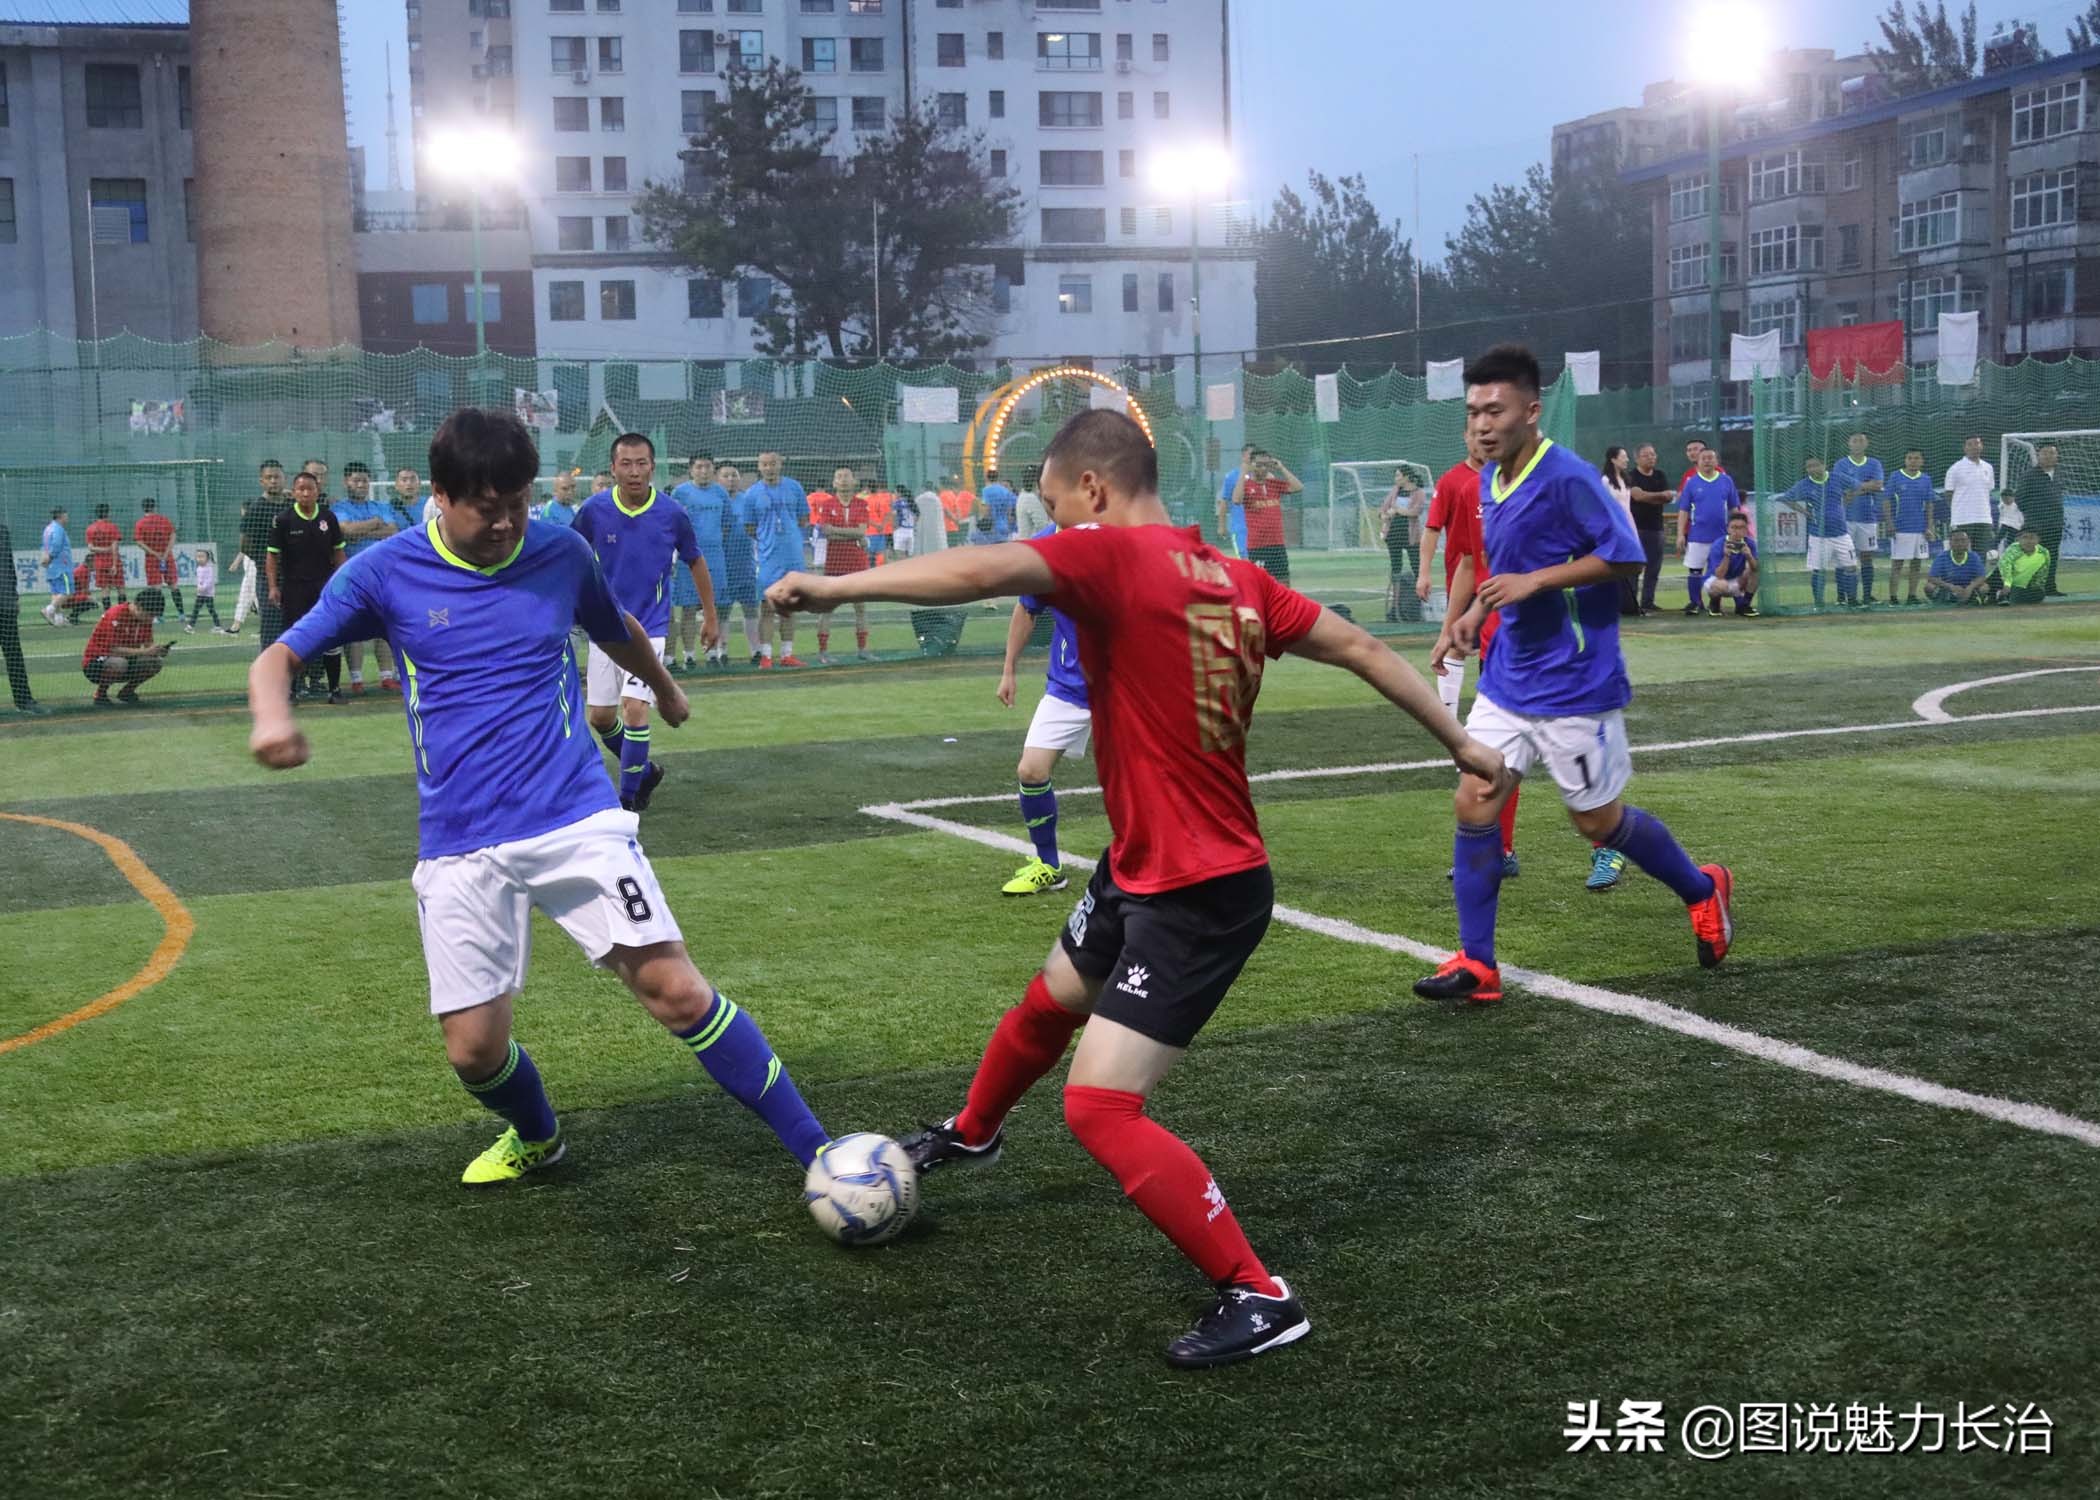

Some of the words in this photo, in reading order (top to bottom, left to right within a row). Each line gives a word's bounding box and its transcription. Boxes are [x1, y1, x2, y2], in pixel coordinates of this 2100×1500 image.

[1574, 753, 1593, 791] 1
[616, 875, 653, 924] 8
[1116, 981, 1149, 999] KELME
